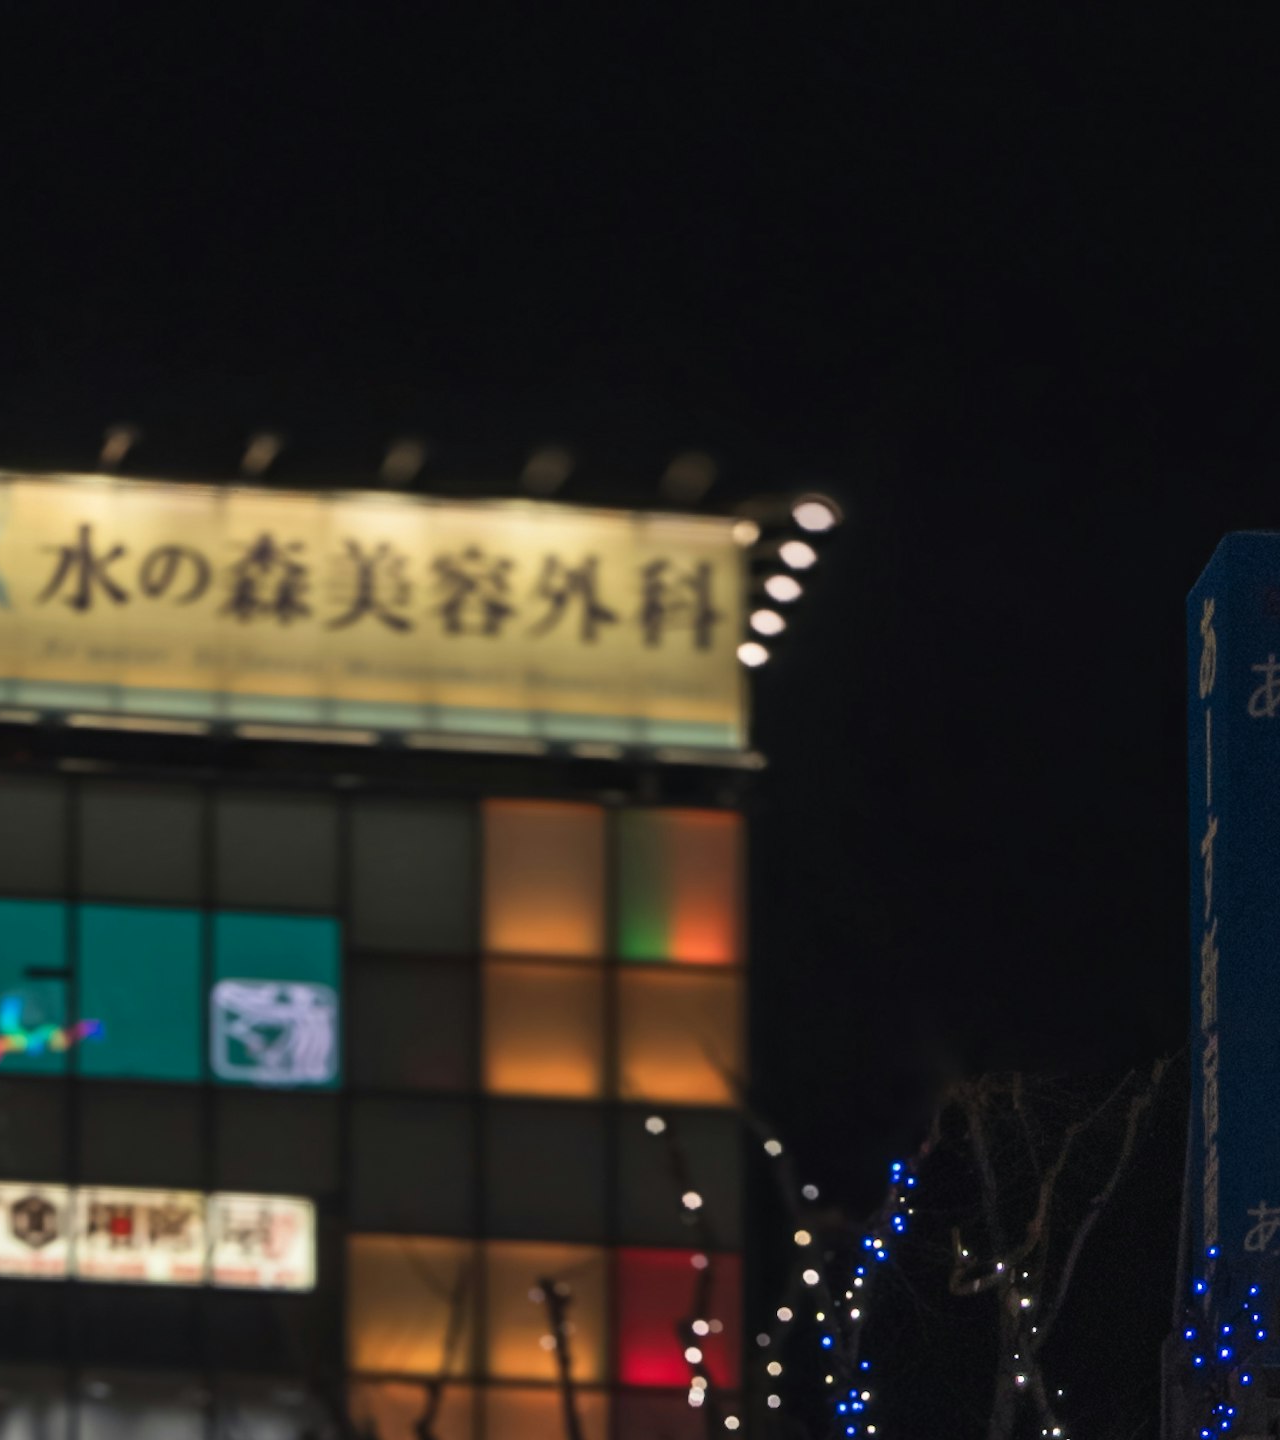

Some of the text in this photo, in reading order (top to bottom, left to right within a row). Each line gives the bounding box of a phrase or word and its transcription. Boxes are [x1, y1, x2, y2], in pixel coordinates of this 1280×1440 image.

[35, 519, 728, 652] 水の森美容外科
